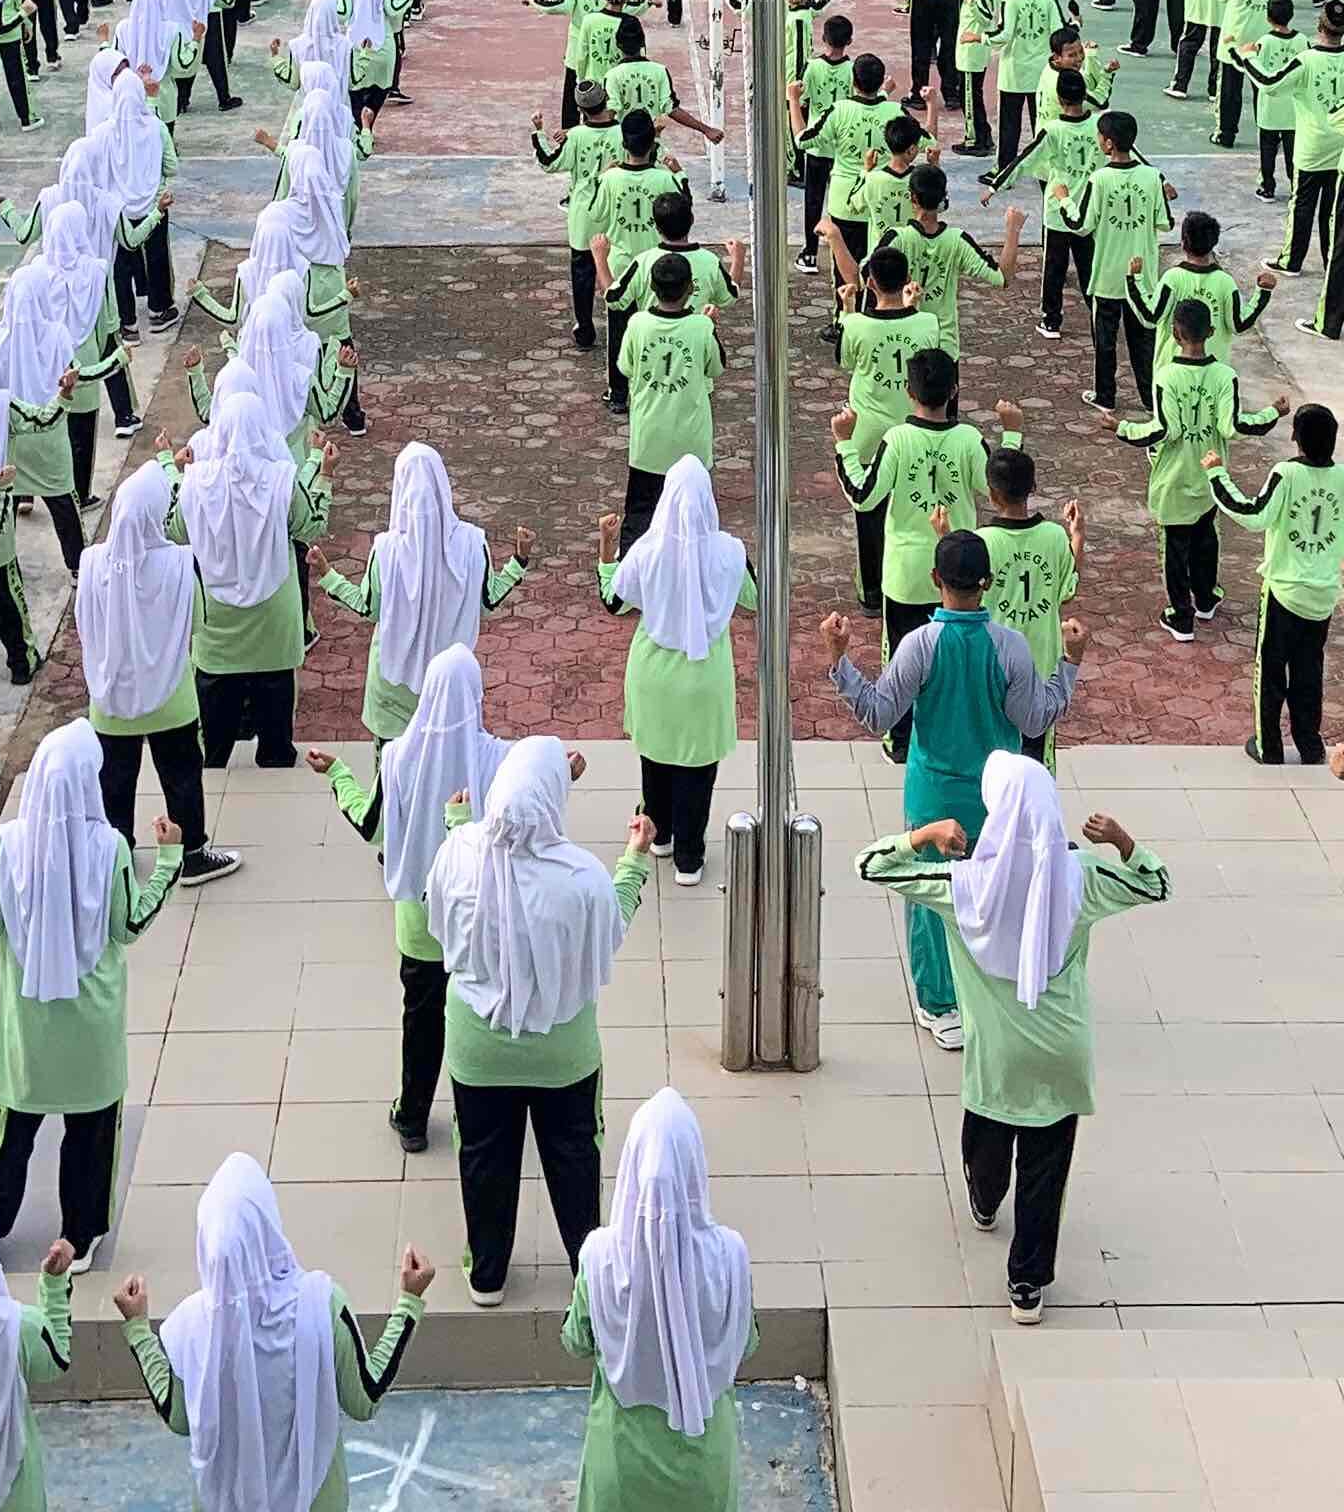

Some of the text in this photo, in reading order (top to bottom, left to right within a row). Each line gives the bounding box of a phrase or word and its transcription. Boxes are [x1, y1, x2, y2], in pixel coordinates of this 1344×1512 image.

[1029, 11, 1034, 29] 1
[604, 37, 611, 54] 1
[635, 84, 641, 103] 1
[831, 88, 837, 104] 1
[1329, 77, 1336, 95] 1
[864, 129, 872, 148] 1
[596, 154, 602, 172] 1
[1077, 147, 1085, 166] 1
[633, 198, 640, 219] 1
[895, 203, 901, 222] 1
[1124, 194, 1131, 216] 1
[618, 216, 655, 232] BATAM
[1108, 214, 1146, 231] BATAM
[922, 265, 929, 287] 1
[1194, 288, 1219, 317] NEGERI
[641, 336, 693, 369] MTs NEGERI
[662, 351, 671, 376] 1
[872, 342, 885, 364] MTs
[893, 349, 902, 374] 1
[642, 375, 689, 394] BATAM
[1192, 403, 1199, 426] 1
[908, 450, 959, 484] MTs NEGERI
[928, 464, 936, 494] 1
[1290, 495, 1307, 519] MTs
[1311, 505, 1321, 536] 1
[1288, 529, 1337, 553] BATAM
[996, 550, 1052, 588] MTs NEGERI
[1019, 570, 1030, 603] 1
[998, 597, 1051, 625] BATAM
